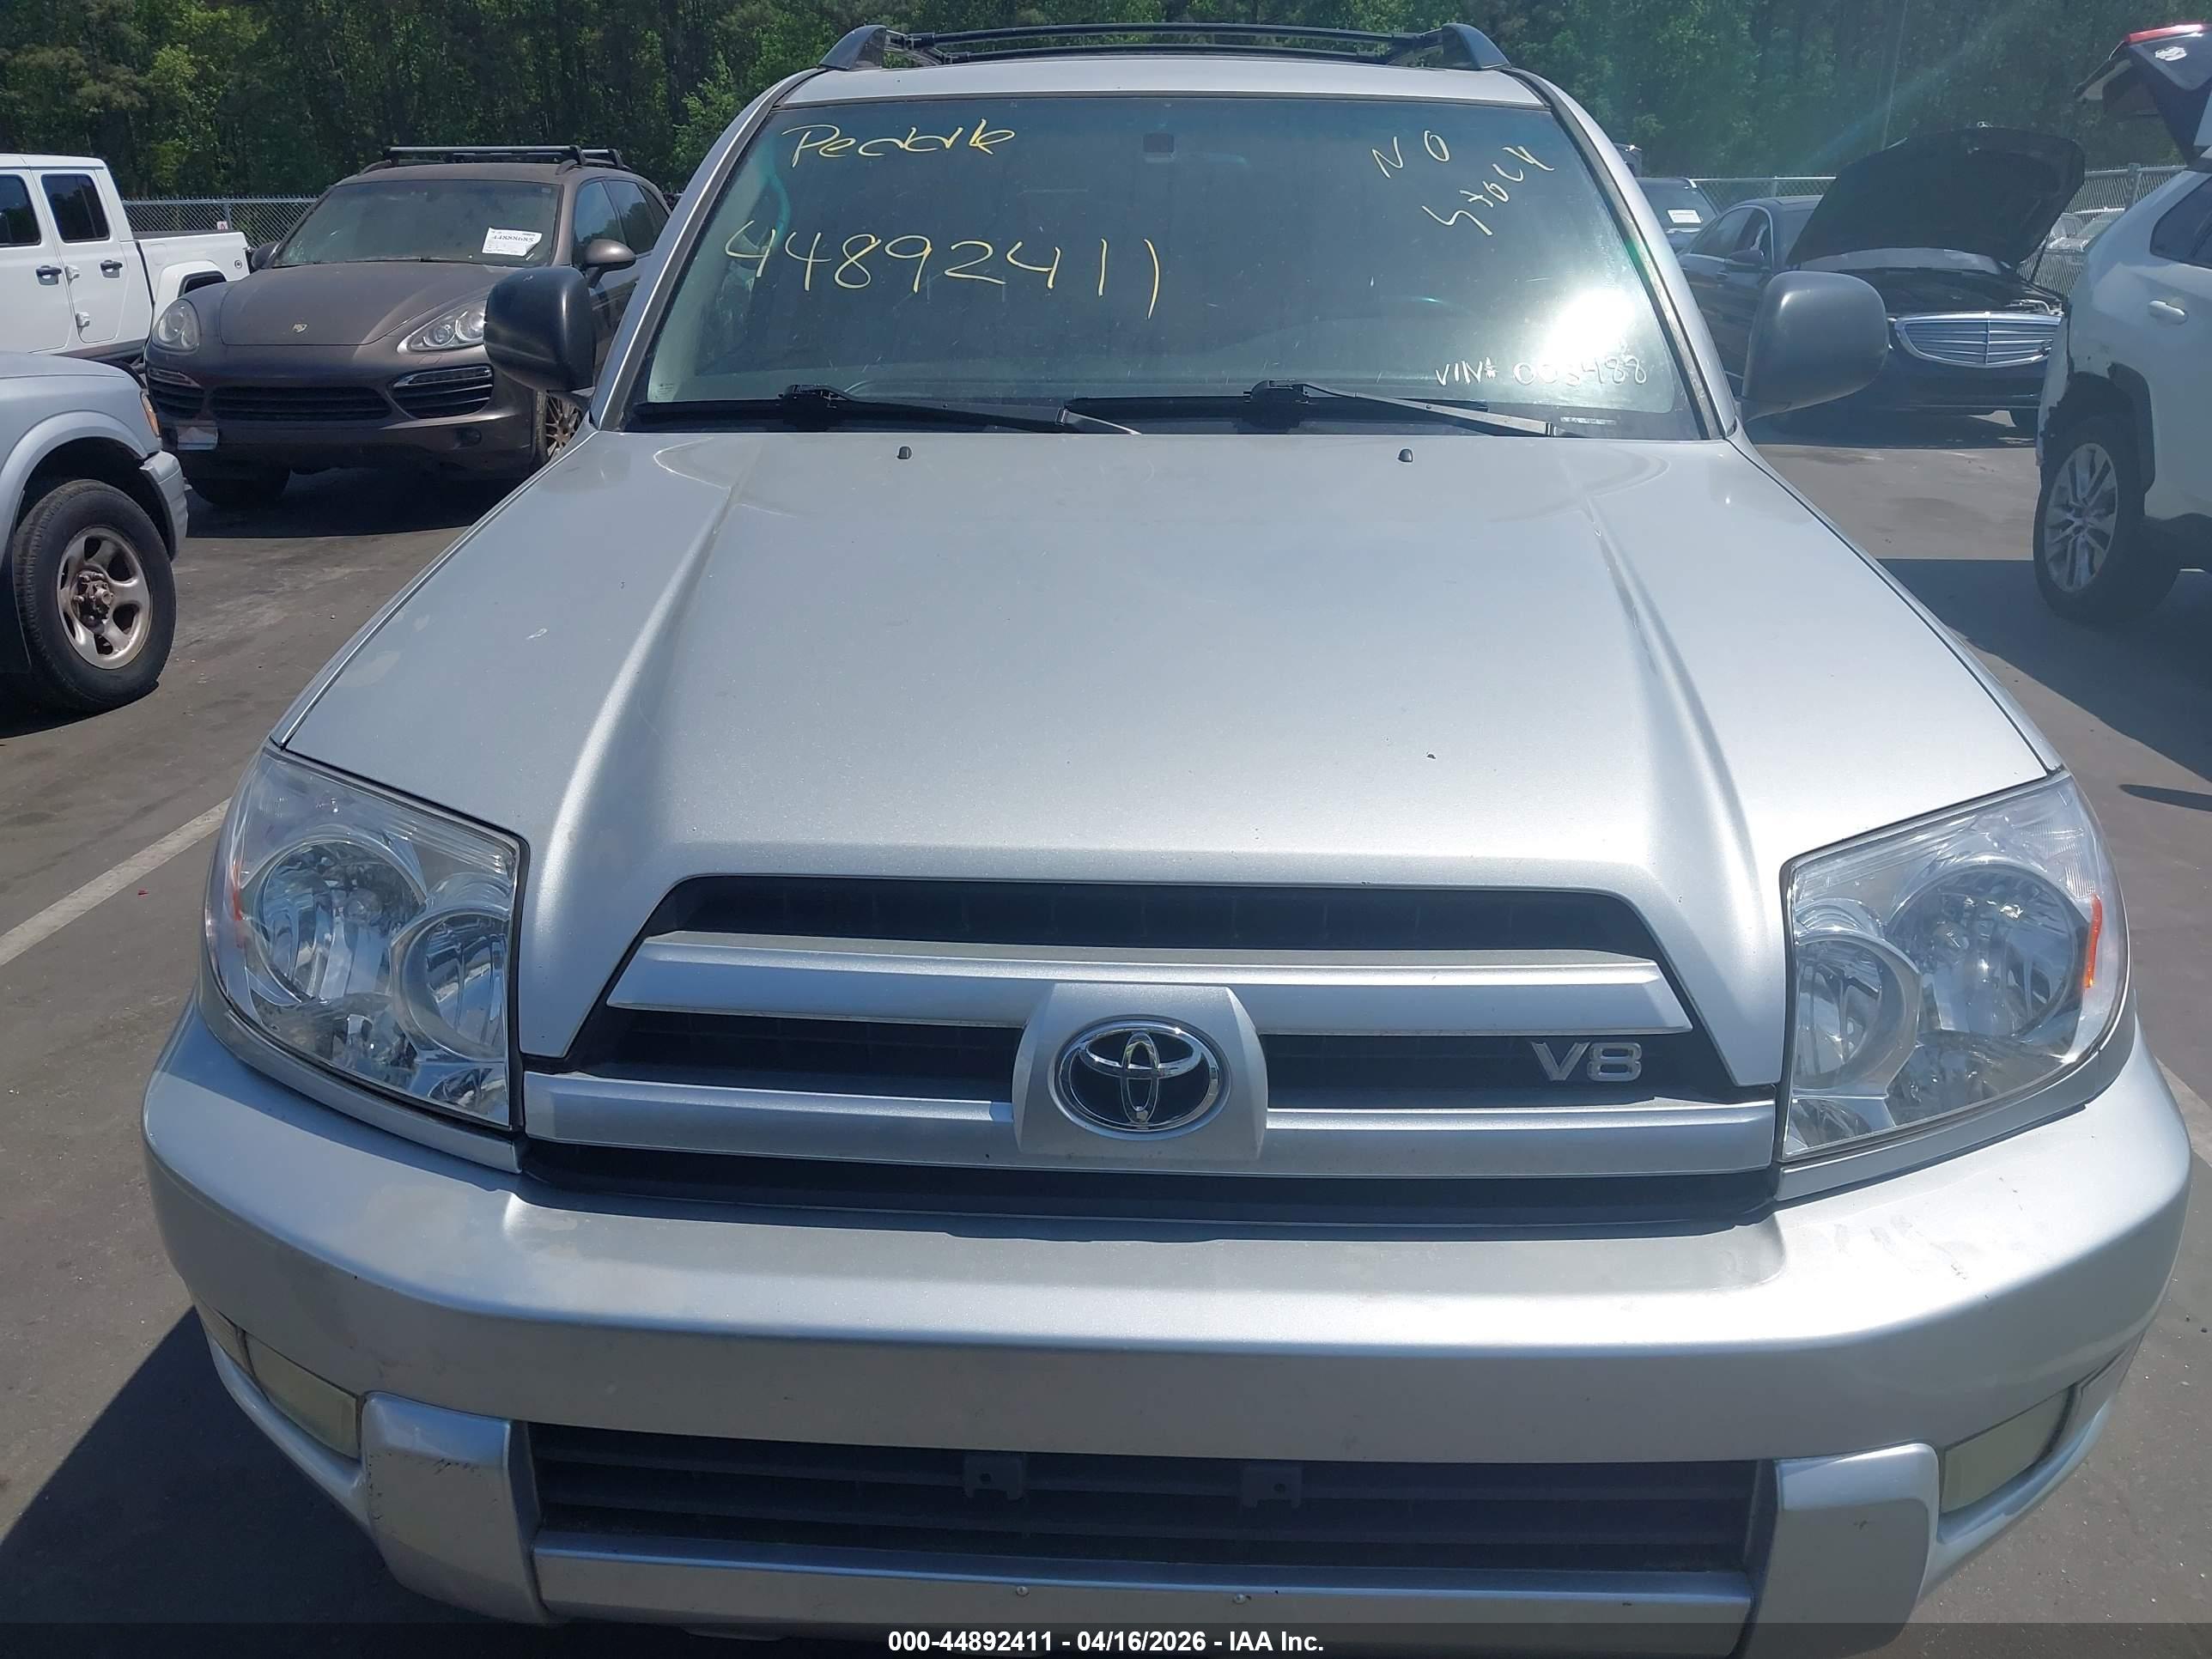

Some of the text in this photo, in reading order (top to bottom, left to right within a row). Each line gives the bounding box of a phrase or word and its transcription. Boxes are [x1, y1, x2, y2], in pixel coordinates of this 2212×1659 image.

[725, 220, 1161, 320] 44892411
[1435, 357, 1498, 386] VIN#
[1530, 1041, 1643, 1082] V8
